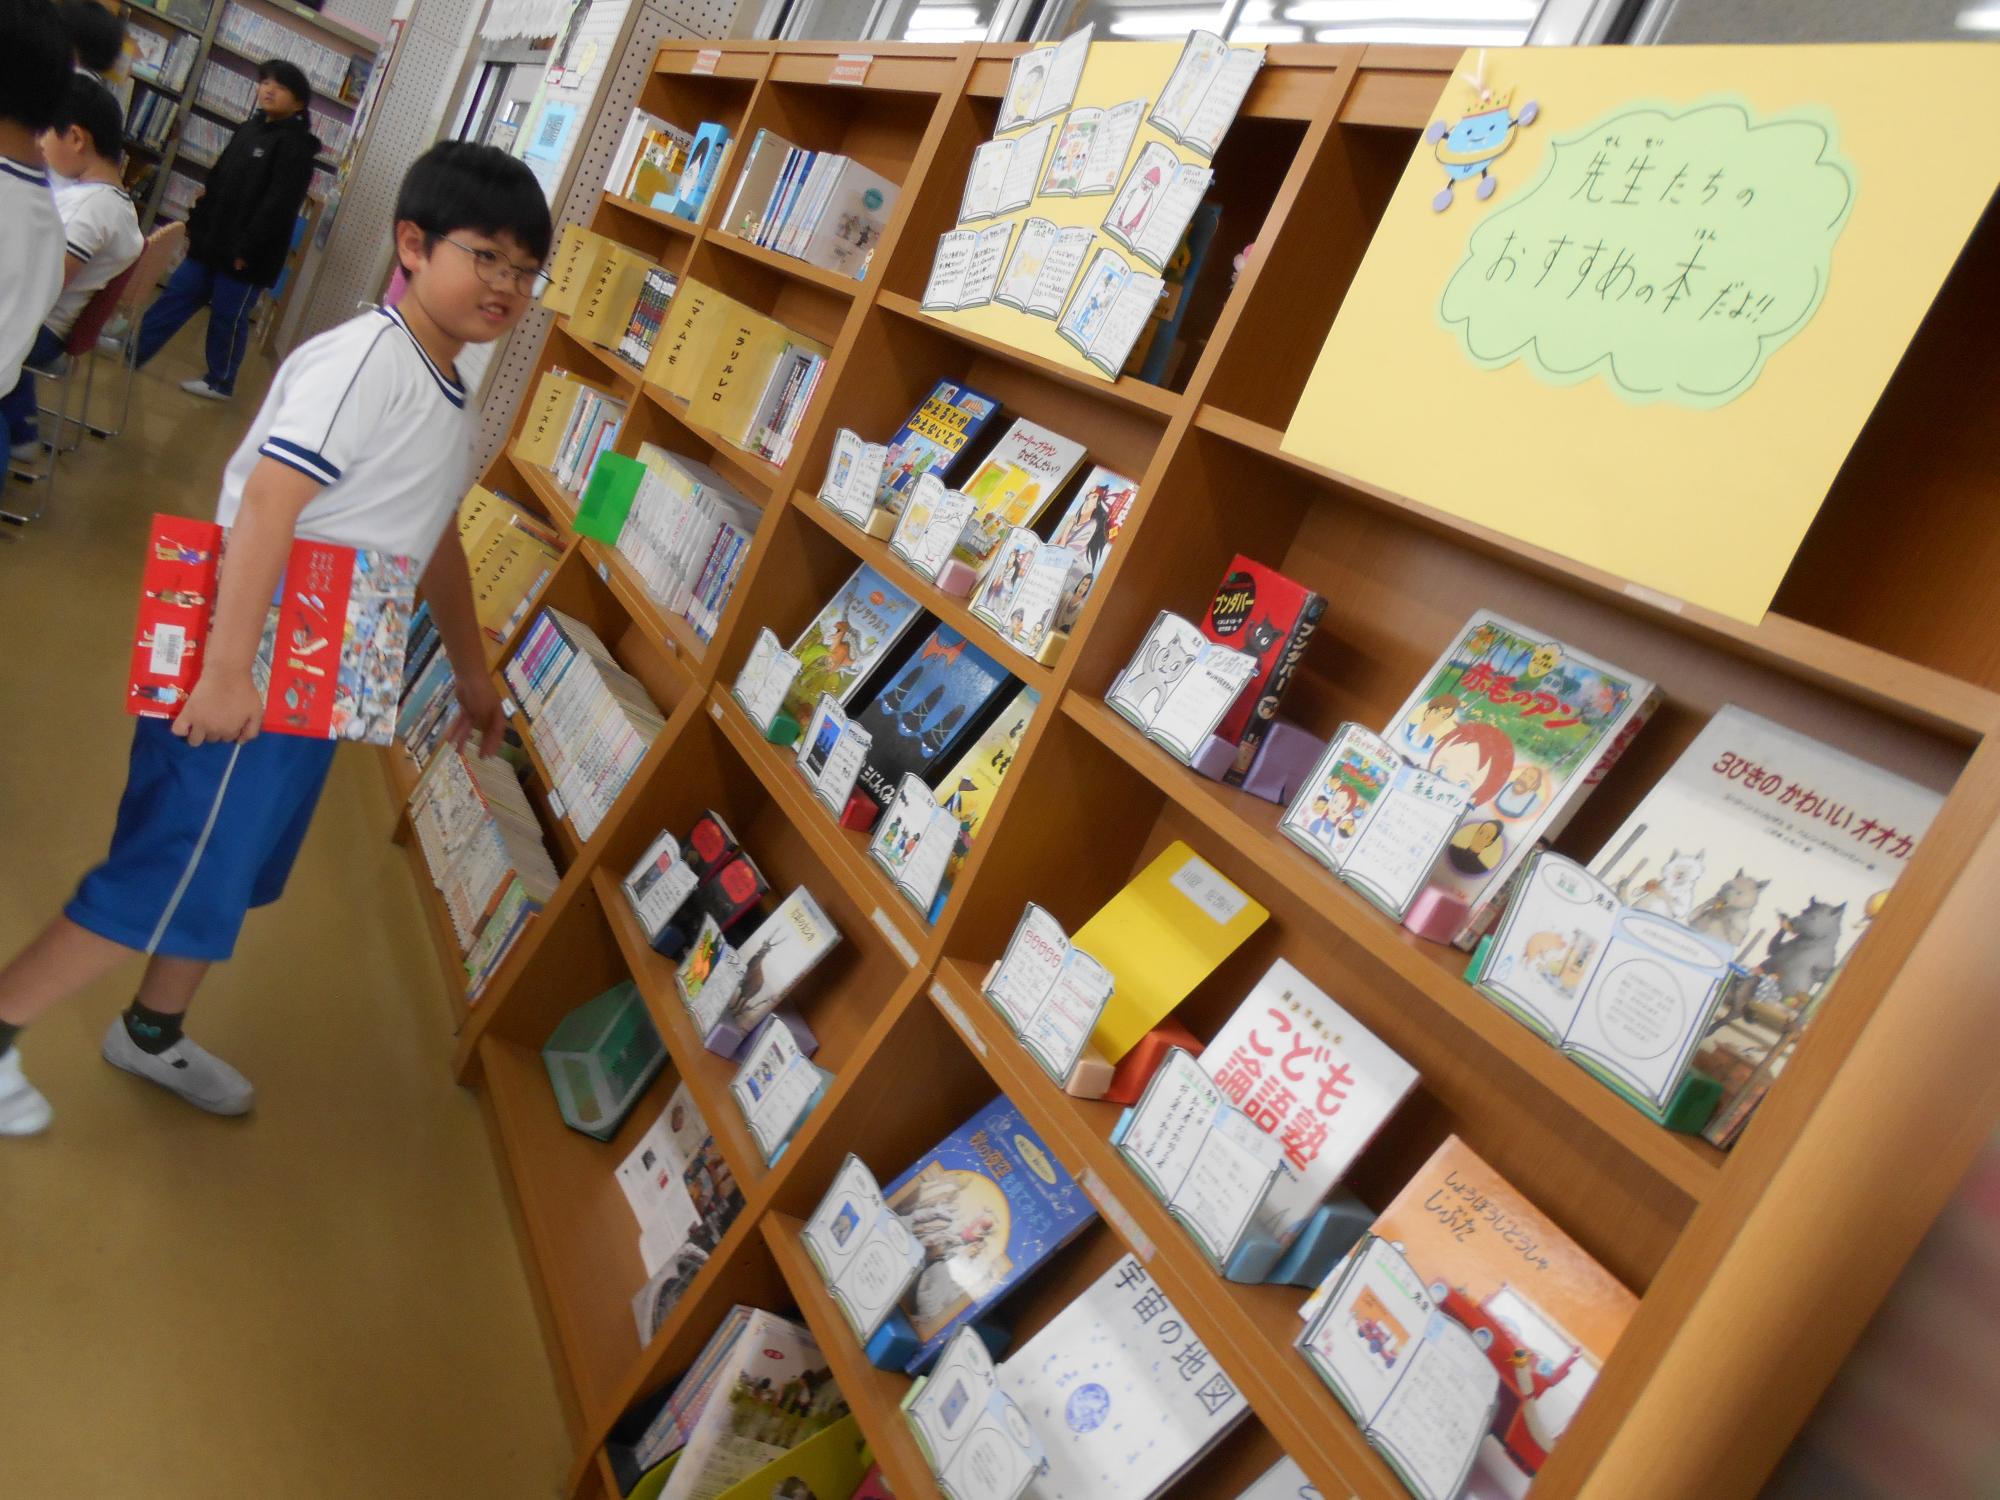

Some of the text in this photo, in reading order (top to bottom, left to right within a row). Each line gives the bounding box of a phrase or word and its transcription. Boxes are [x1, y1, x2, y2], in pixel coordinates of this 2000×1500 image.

[1570, 152, 1756, 206] 先生たちの
[586, 266, 612, 318] カキクケコ
[668, 306, 700, 366] マミムメモ
[712, 336, 745, 402] ラリルレロ
[910, 414, 965, 450] みえないとか
[921, 399, 968, 428] みえるとか
[1461, 662, 1581, 729] 赤毛のアン
[1712, 751, 1913, 861] 3びきのかわいいオオカ
[1249, 1008, 1355, 1116] こども
[1214, 1046, 1328, 1171] 論語塾
[1114, 1260, 1237, 1417] 宇宙の地図
